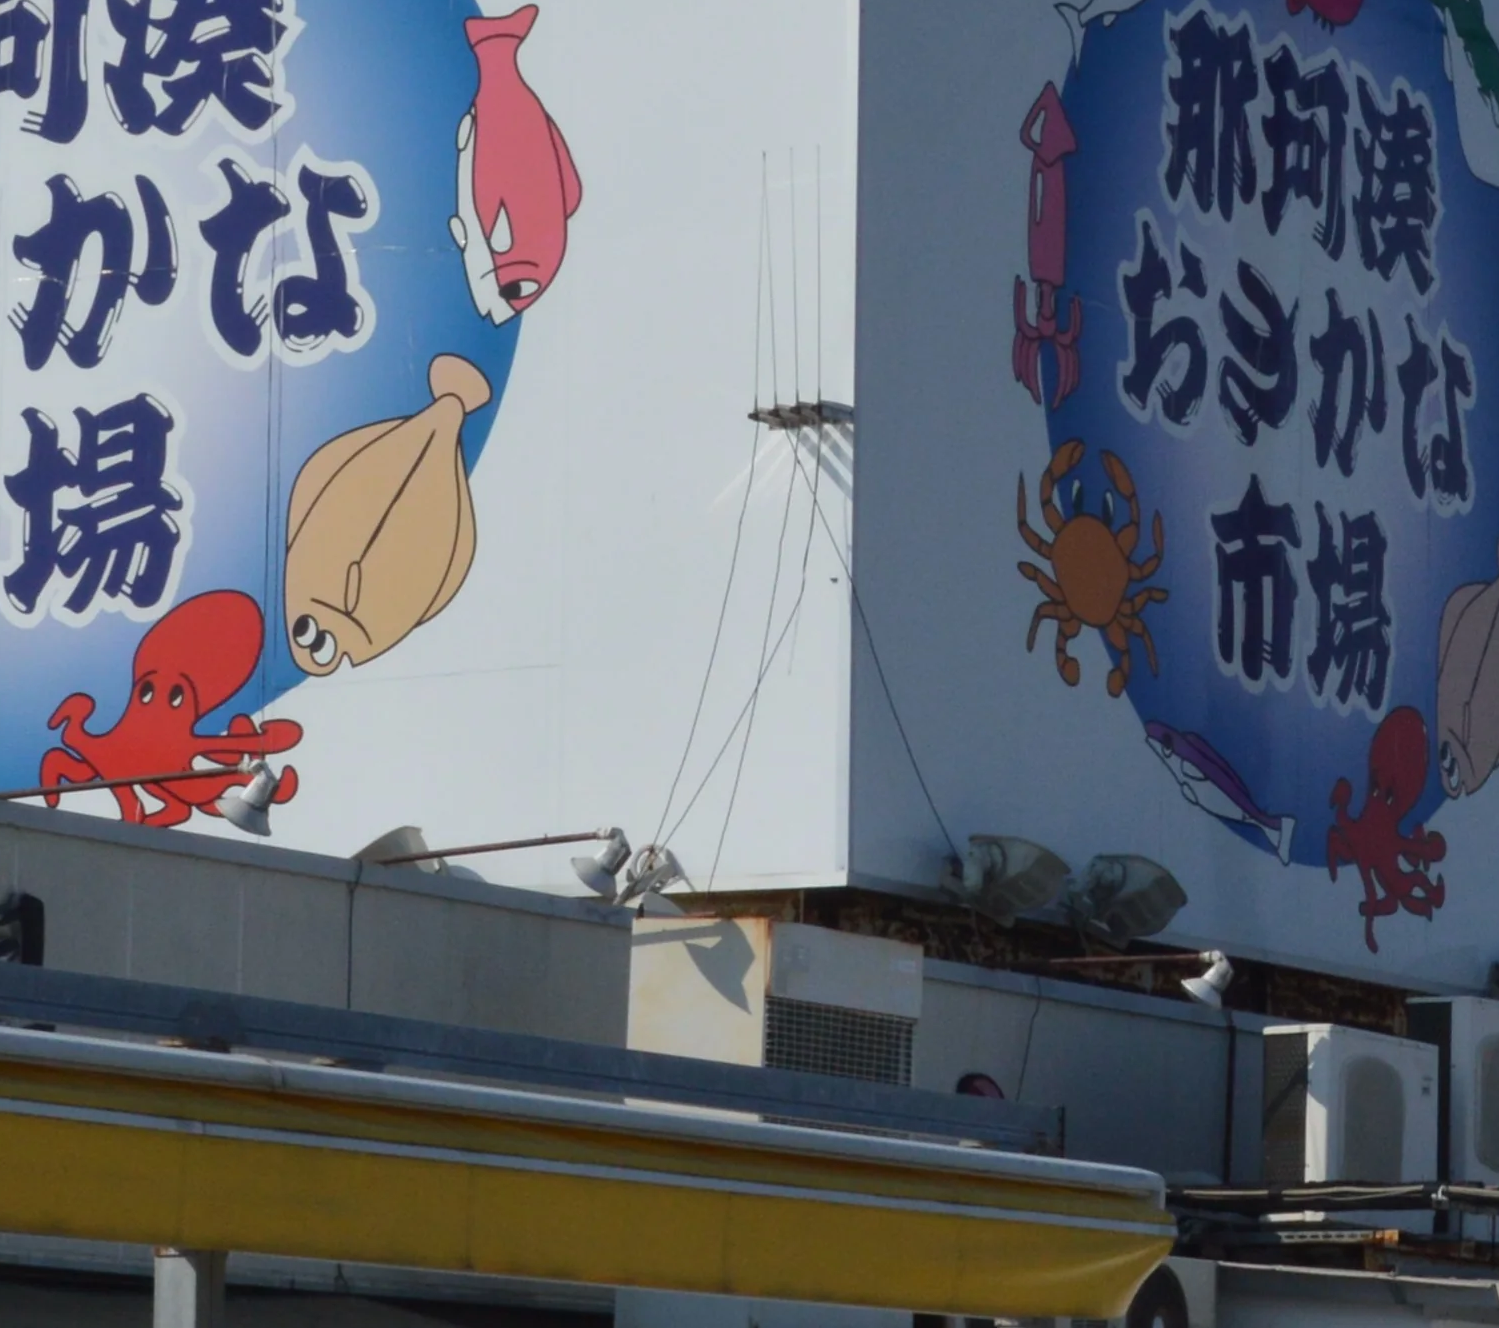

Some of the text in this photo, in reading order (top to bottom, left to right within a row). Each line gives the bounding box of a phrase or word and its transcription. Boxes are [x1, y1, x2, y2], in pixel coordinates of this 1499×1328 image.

[1118, 207, 1475, 513] おさかな
[1209, 474, 1393, 716] 市場
